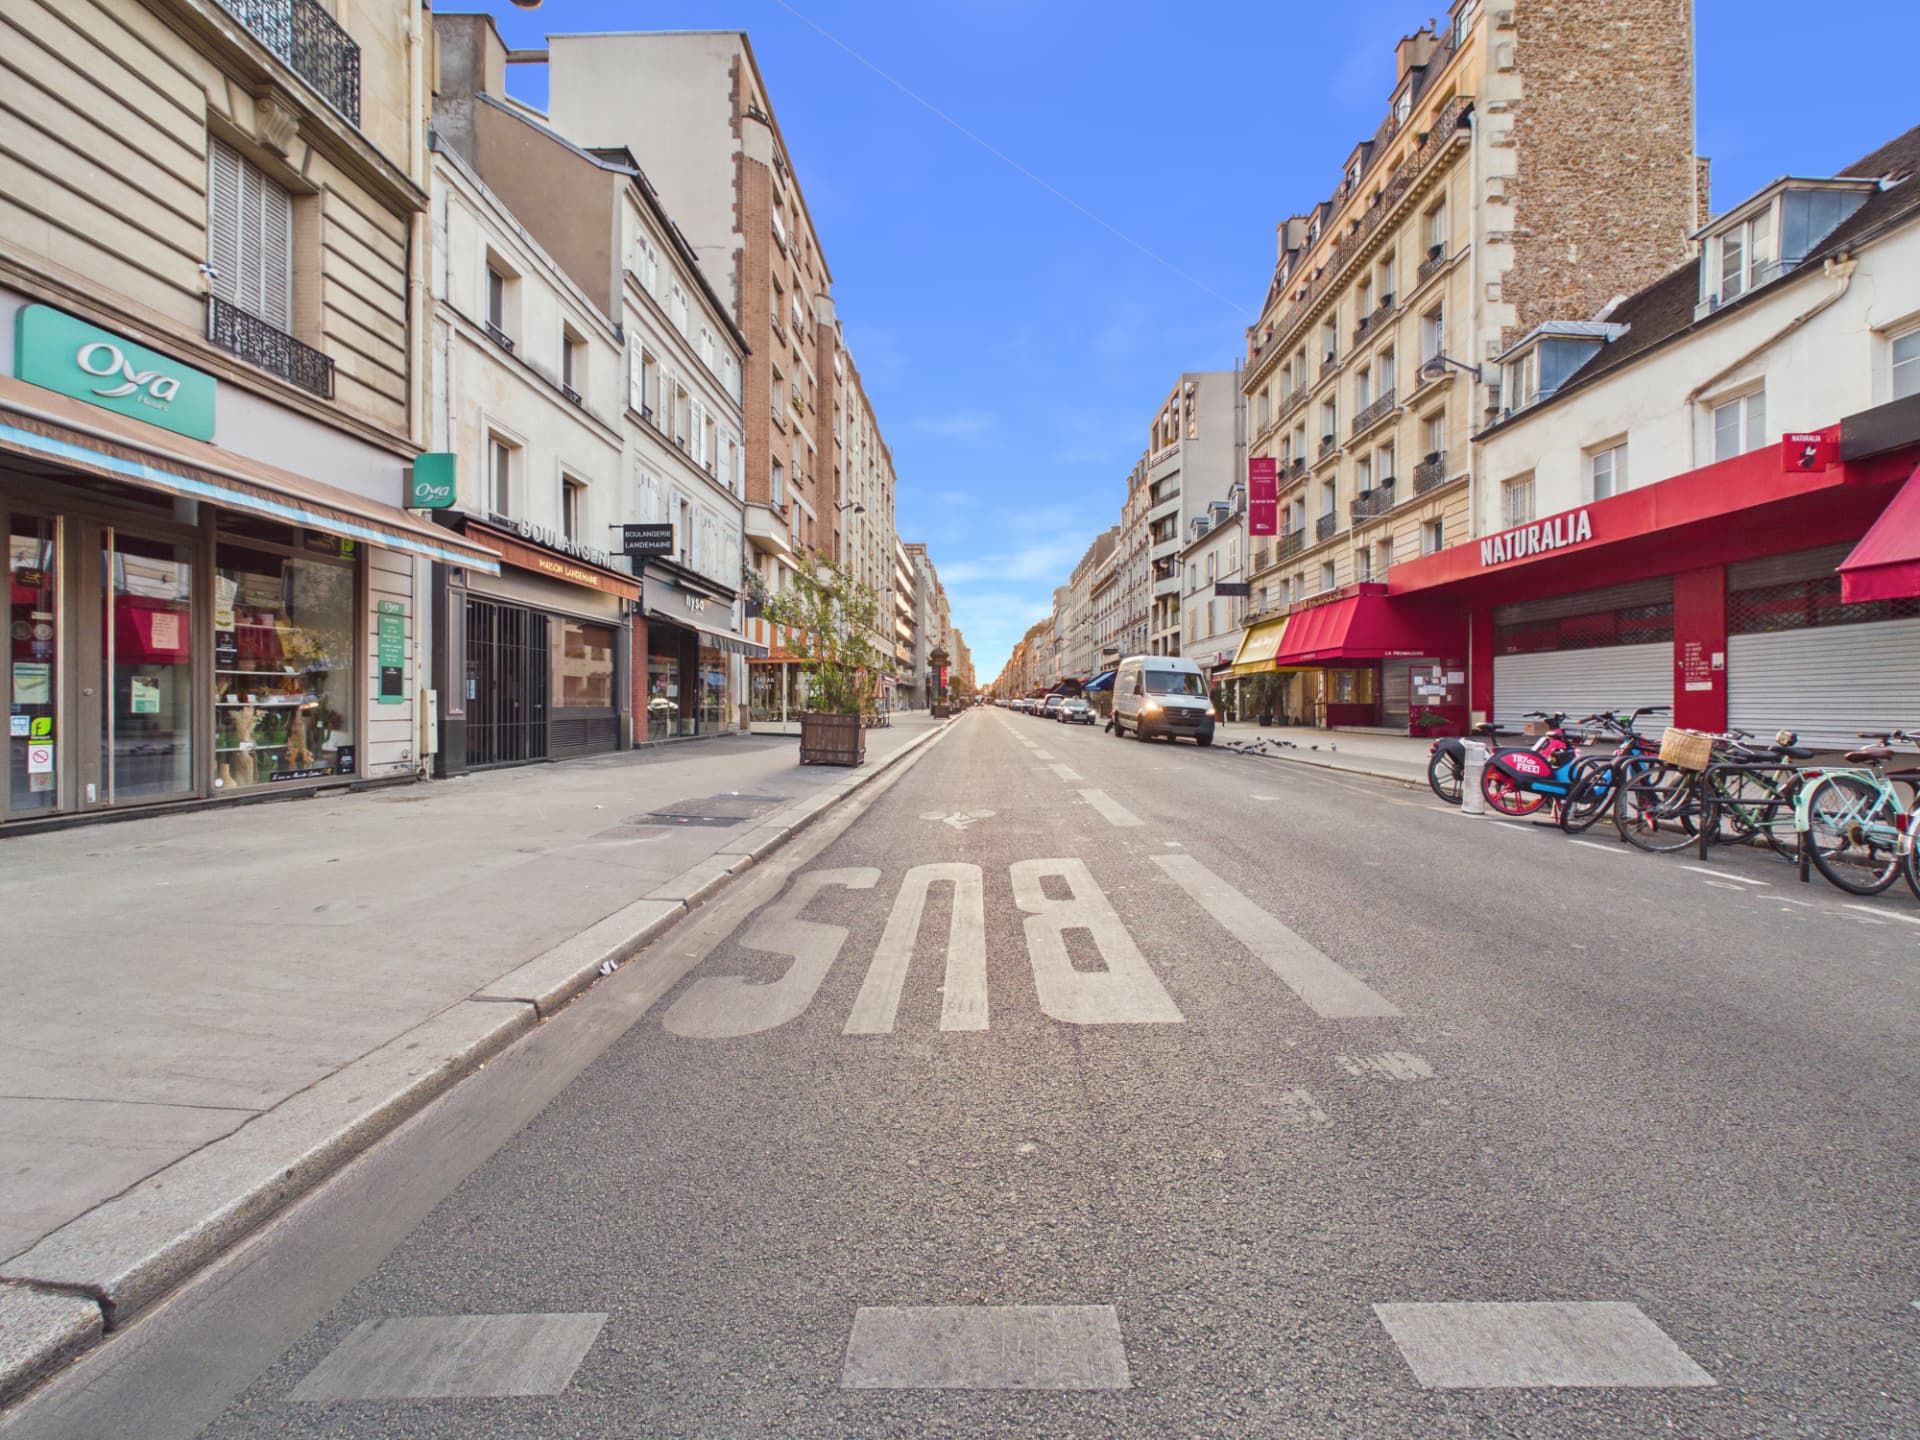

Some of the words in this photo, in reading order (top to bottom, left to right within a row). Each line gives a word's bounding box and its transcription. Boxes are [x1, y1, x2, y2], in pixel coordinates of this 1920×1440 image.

[77, 342, 181, 402] Oya
[1791, 434, 1821, 442] NATURALIA
[415, 482, 450, 503] Oya
[625, 530, 672, 538] BOULANGERIE
[1480, 510, 1593, 567] NATURALIA
[520, 519, 617, 570] BOULANGERIE
[625, 541, 672, 549] LANDEMAINE
[539, 559, 564, 574] MAISON
[564, 566, 599, 585] LANDEMAINE
[662, 857, 1185, 1040] BUS
